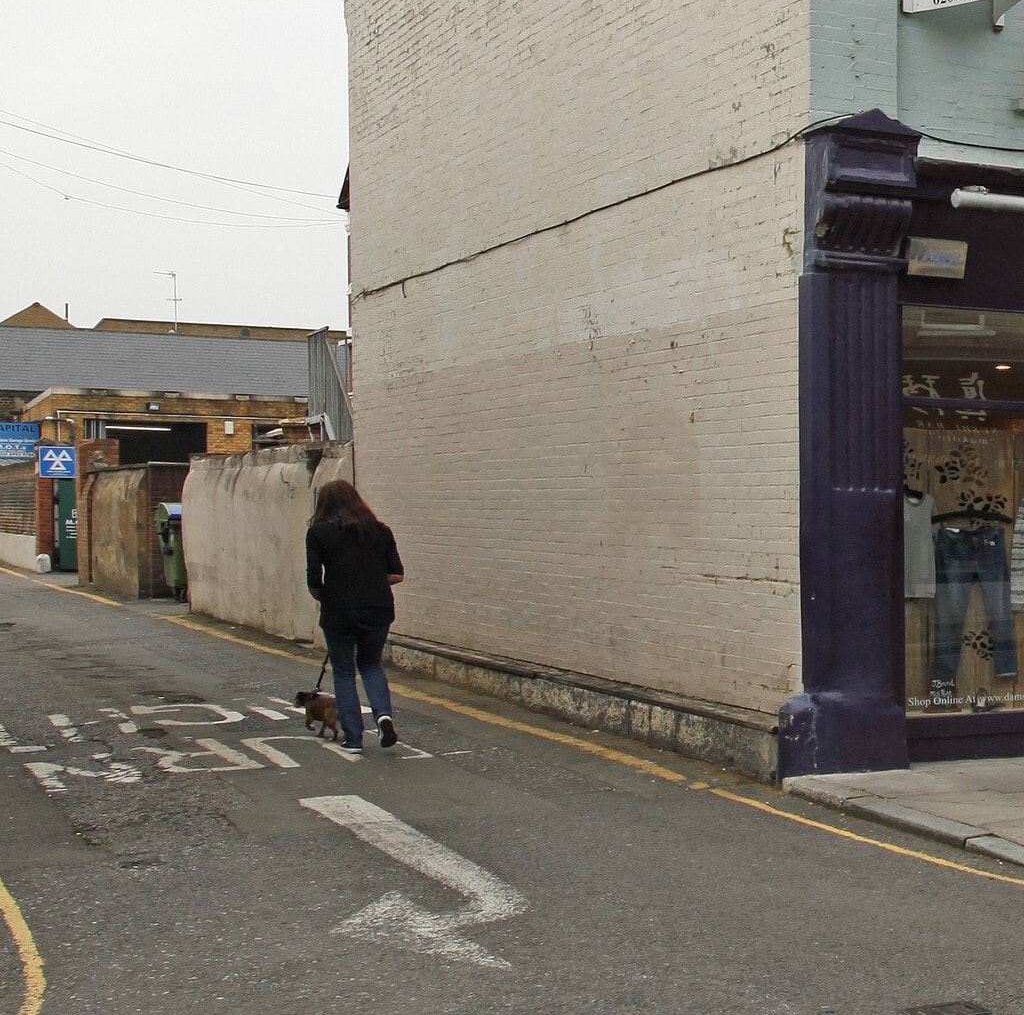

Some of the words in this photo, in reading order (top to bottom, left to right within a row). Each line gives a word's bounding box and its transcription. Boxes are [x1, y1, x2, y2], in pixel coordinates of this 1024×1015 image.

[0, 425, 36, 433] APITAL
[908, 696, 931, 708] Shop
[933, 695, 963, 706] Online
[965, 695, 976, 704] At
